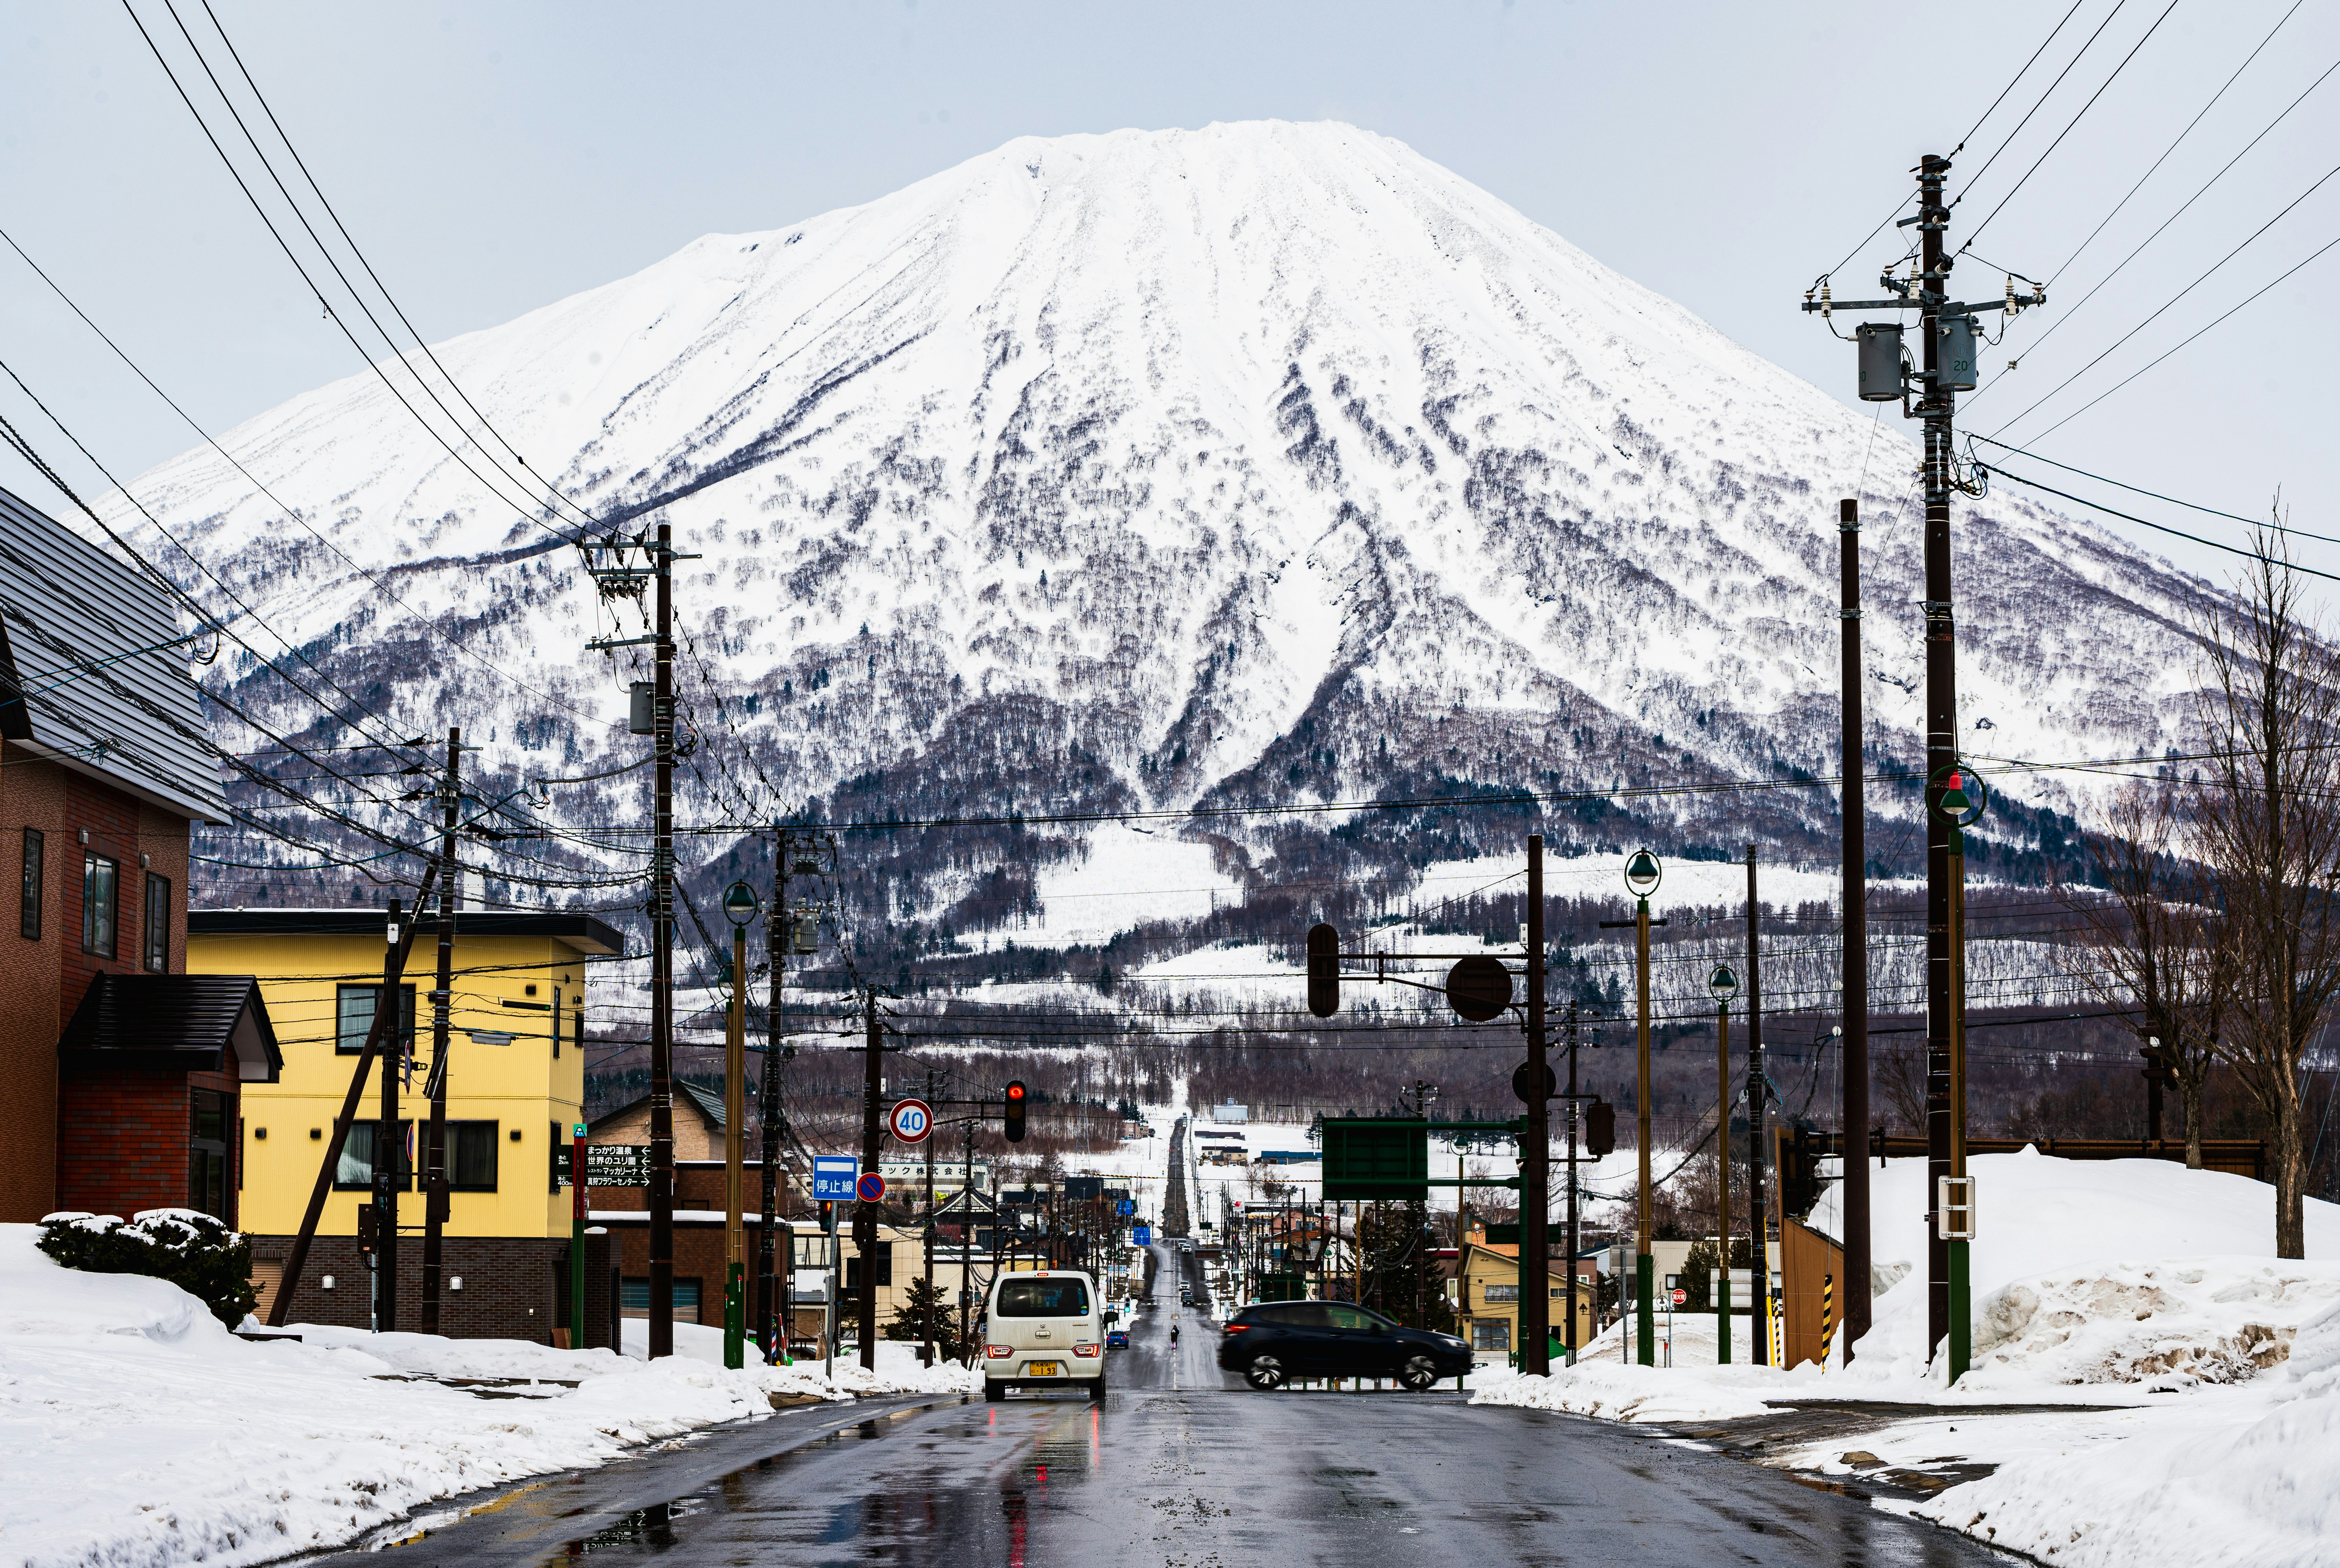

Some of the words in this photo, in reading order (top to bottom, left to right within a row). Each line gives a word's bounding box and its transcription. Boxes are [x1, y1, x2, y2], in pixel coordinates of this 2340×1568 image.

[1954, 360, 1967, 371] 20
[900, 1112, 923, 1130] 40
[588, 1146, 632, 1155] まっかり温泉
[588, 1157, 636, 1165] 世界のユリ園
[817, 1179, 853, 1193] 停止線
